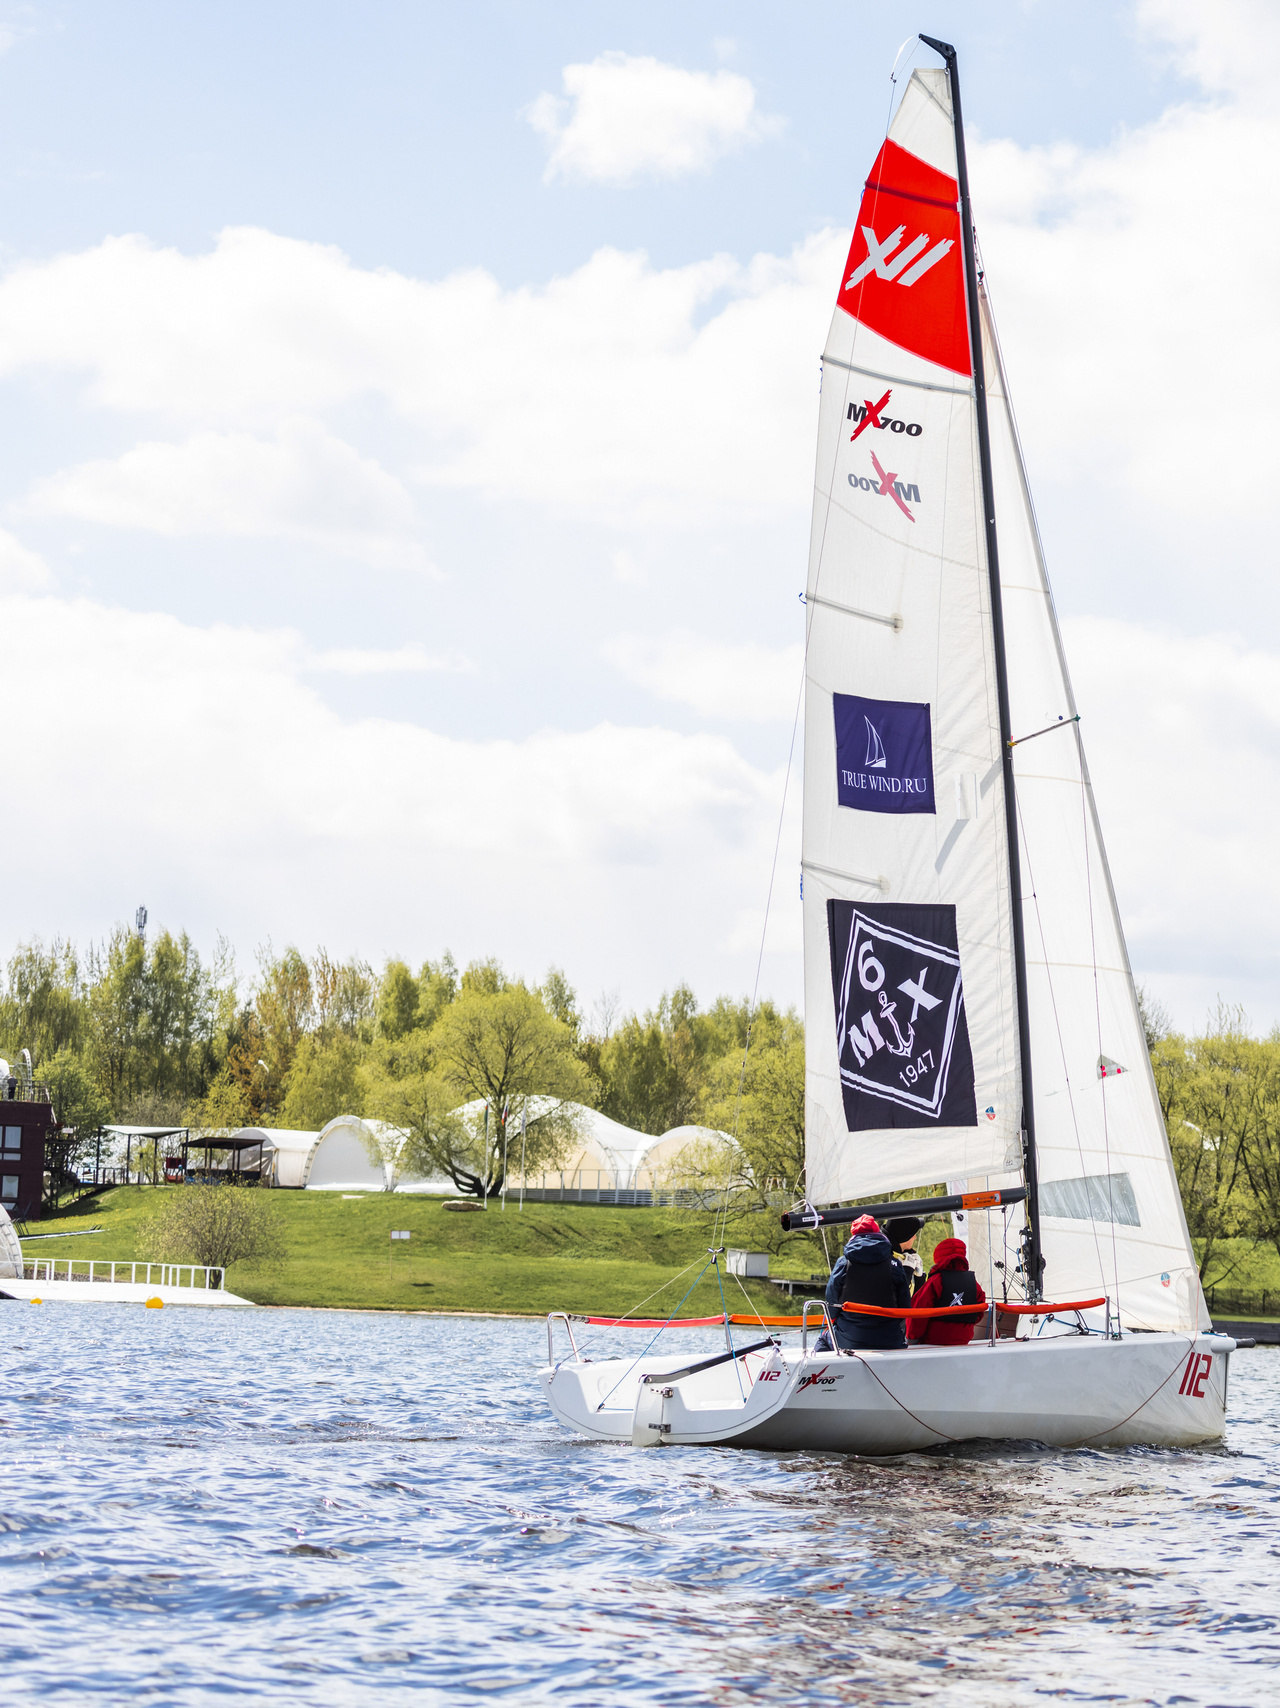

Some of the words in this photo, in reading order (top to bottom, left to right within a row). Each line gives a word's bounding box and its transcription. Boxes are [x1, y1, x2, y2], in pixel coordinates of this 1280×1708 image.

[846, 389, 923, 442] MX700
[841, 769, 867, 790] TRUE
[869, 774, 927, 794] WIND.RU
[899, 1049, 936, 1088] 1947
[758, 1370, 782, 1382] 112
[796, 1365, 836, 1394] MX700
[1178, 1351, 1213, 1398] 112
